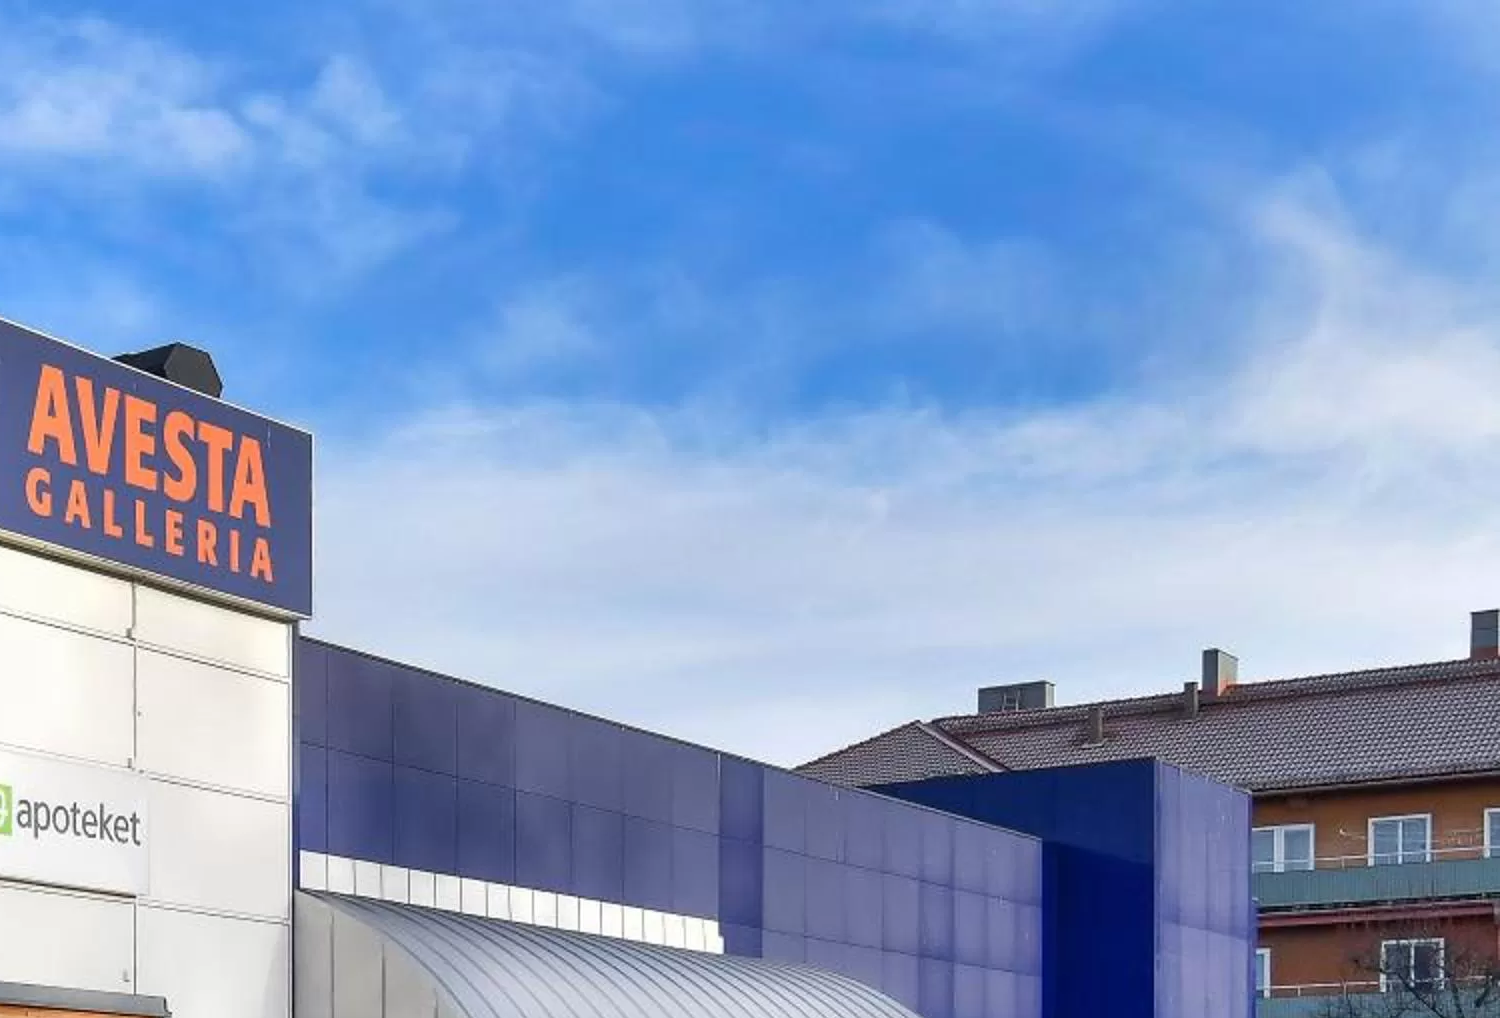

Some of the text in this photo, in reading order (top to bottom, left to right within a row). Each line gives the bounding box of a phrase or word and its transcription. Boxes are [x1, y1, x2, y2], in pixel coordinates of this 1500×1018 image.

[26, 363, 272, 528] AVESTA
[24, 466, 275, 583] GALLERIA
[16, 798, 142, 846] apoteket
